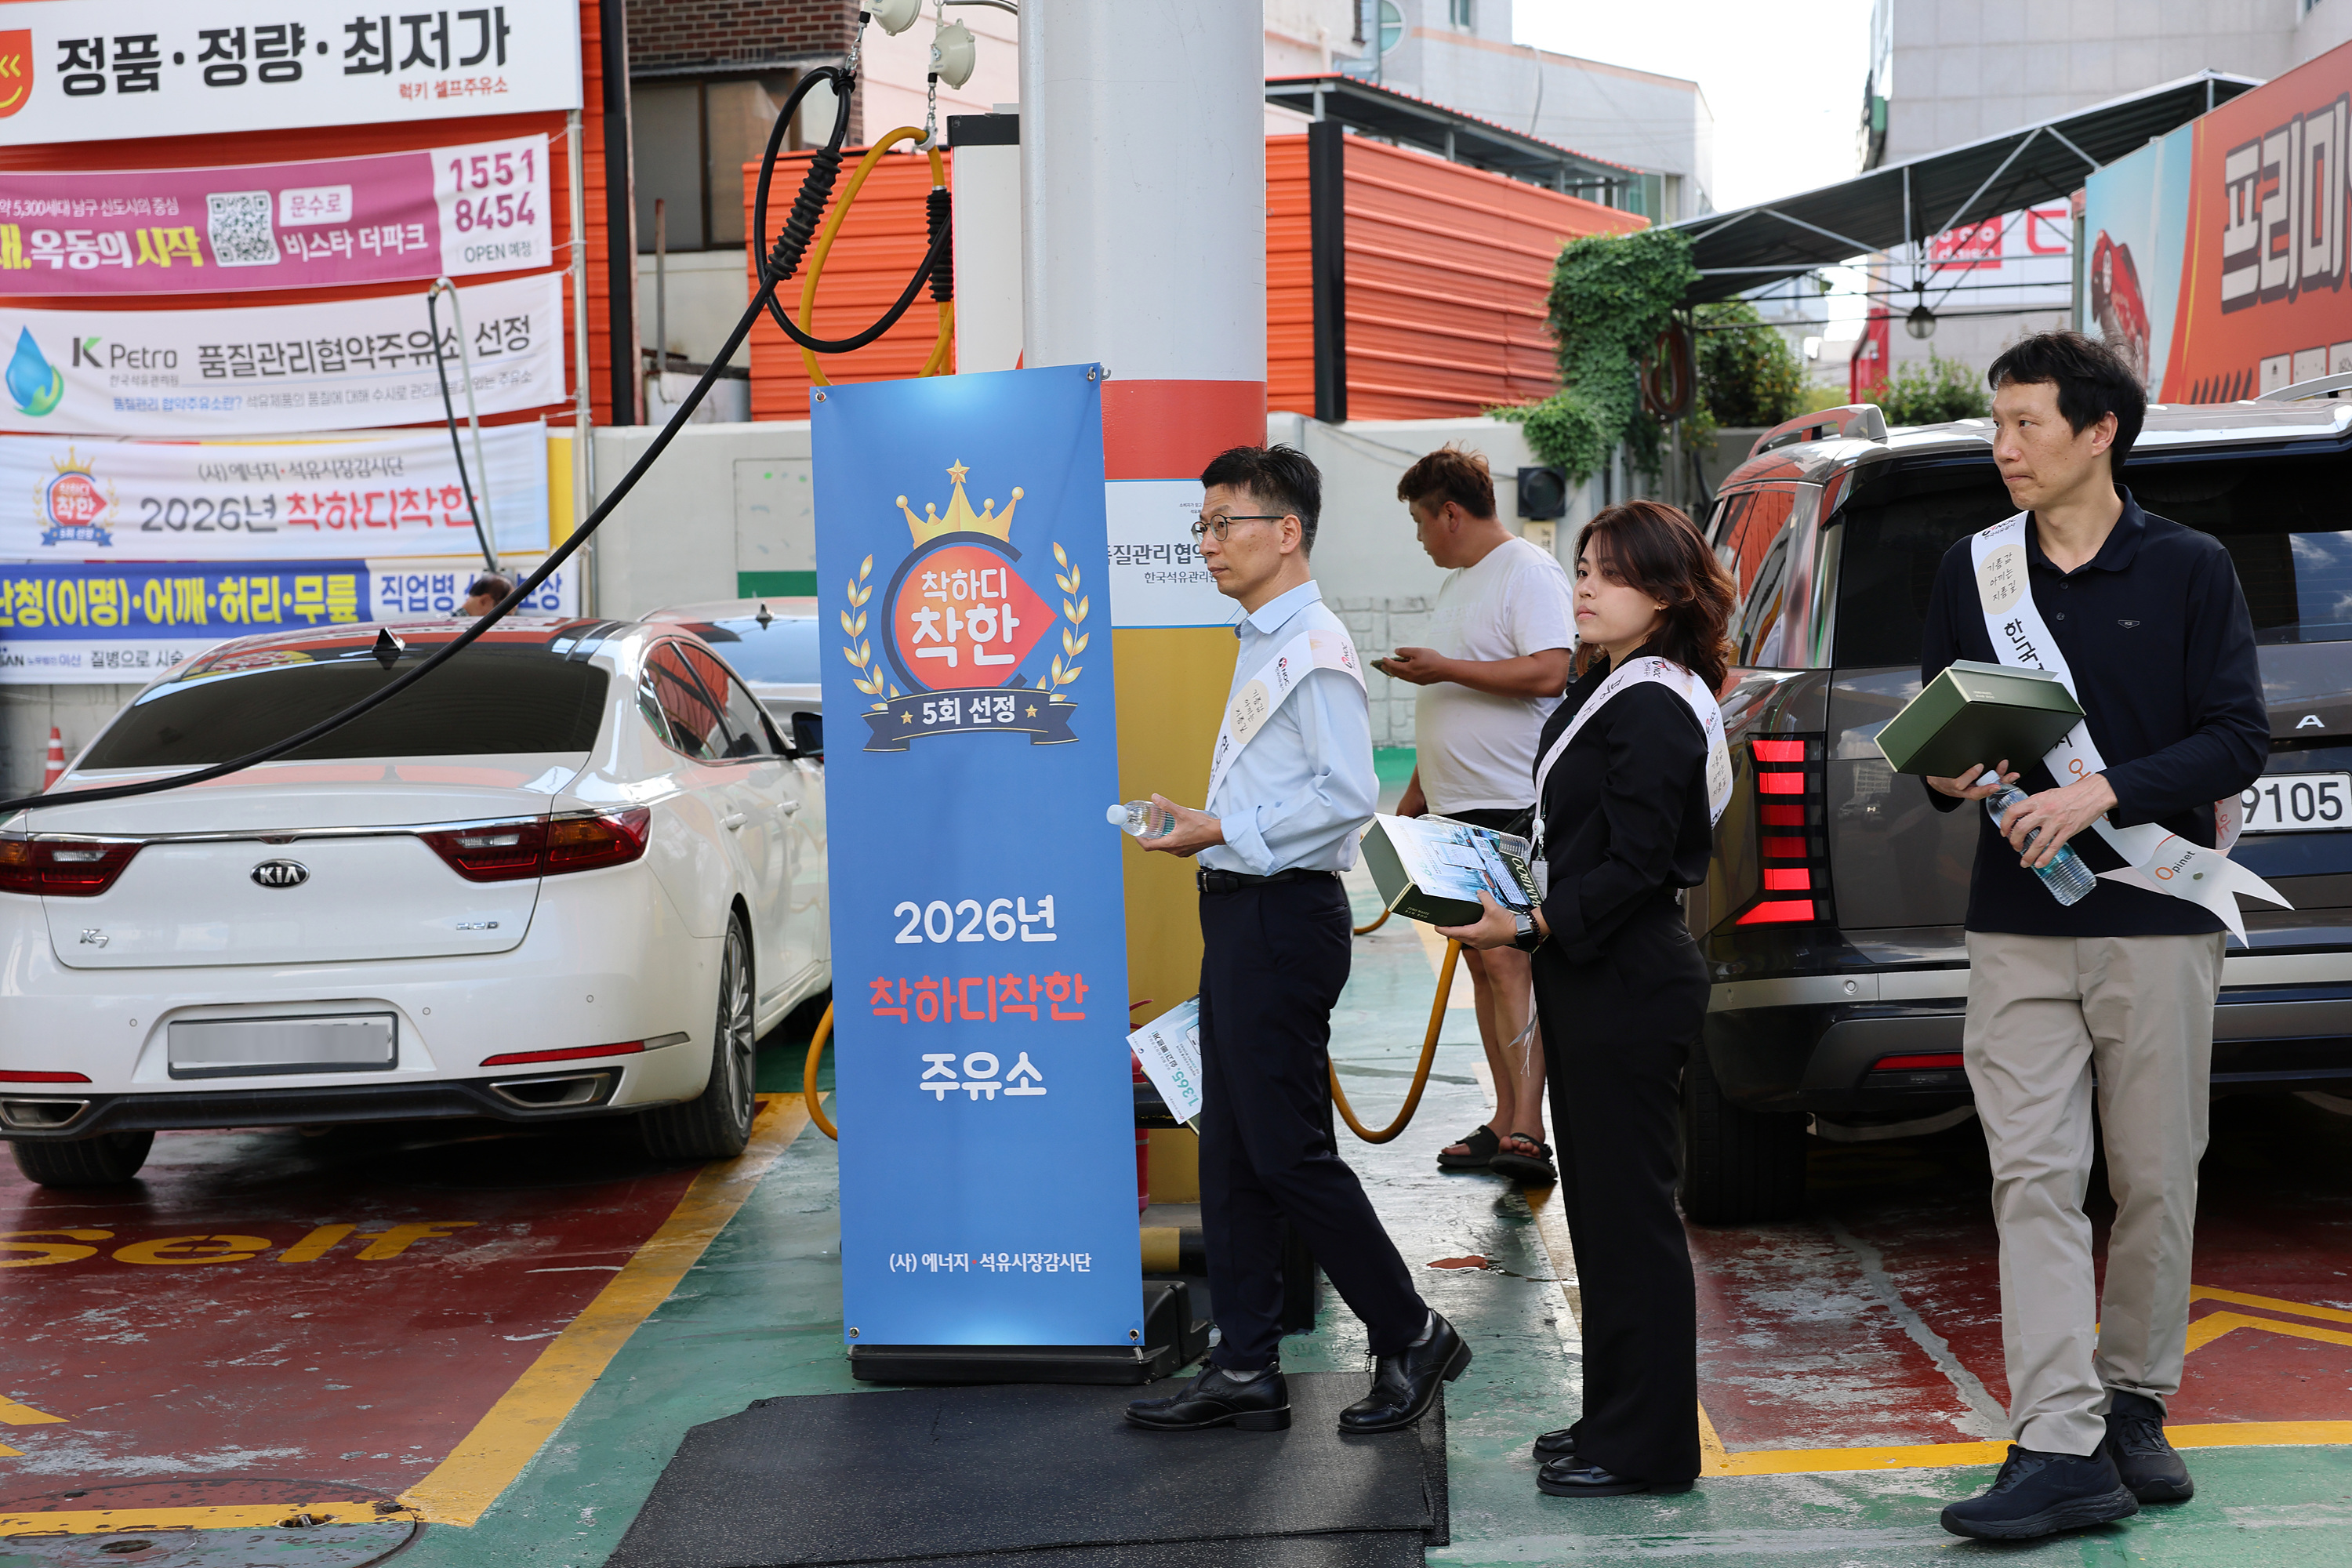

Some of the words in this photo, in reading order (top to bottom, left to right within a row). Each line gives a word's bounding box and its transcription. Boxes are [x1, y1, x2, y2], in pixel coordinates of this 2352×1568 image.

[399, 81, 428, 100] 럭키
[434, 76, 507, 99] 셀프주유소
[449, 149, 535, 193] 1551
[72, 198, 98, 217] 남구
[100, 198, 152, 216] 신도시의
[152, 197, 180, 216] 중심
[290, 193, 343, 218] 문수로
[455, 191, 535, 233] 8454
[2221, 93, 2352, 315] 프리미
[136, 226, 204, 268] 시작
[282, 228, 354, 262] 비스타
[358, 223, 429, 257] 더파크
[464, 245, 506, 263] OPEN
[510, 241, 532, 257] 예정
[198, 327, 462, 379] 품질관리협약주유소
[475, 314, 532, 358] 선정
[140, 493, 278, 533] 2026년
[286, 484, 479, 532] 착하디착한
[381, 572, 455, 613] 직업병
[921, 567, 1007, 602] 착하디
[1989, 568, 2014, 586] 아끼는
[1993, 580, 2017, 601] 지름길
[910, 602, 1020, 668] 착한
[91, 650, 151, 669] 질병으로
[921, 697, 962, 727] 5회
[968, 695, 1016, 724] 선정
[260, 866, 300, 884] KIA
[2154, 850, 2197, 880] Opinet
[80, 928, 109, 948] K7
[893, 894, 1058, 945] 2026년
[869, 971, 1090, 1025] 착하디착한
[919, 1051, 1047, 1101] 주유소
